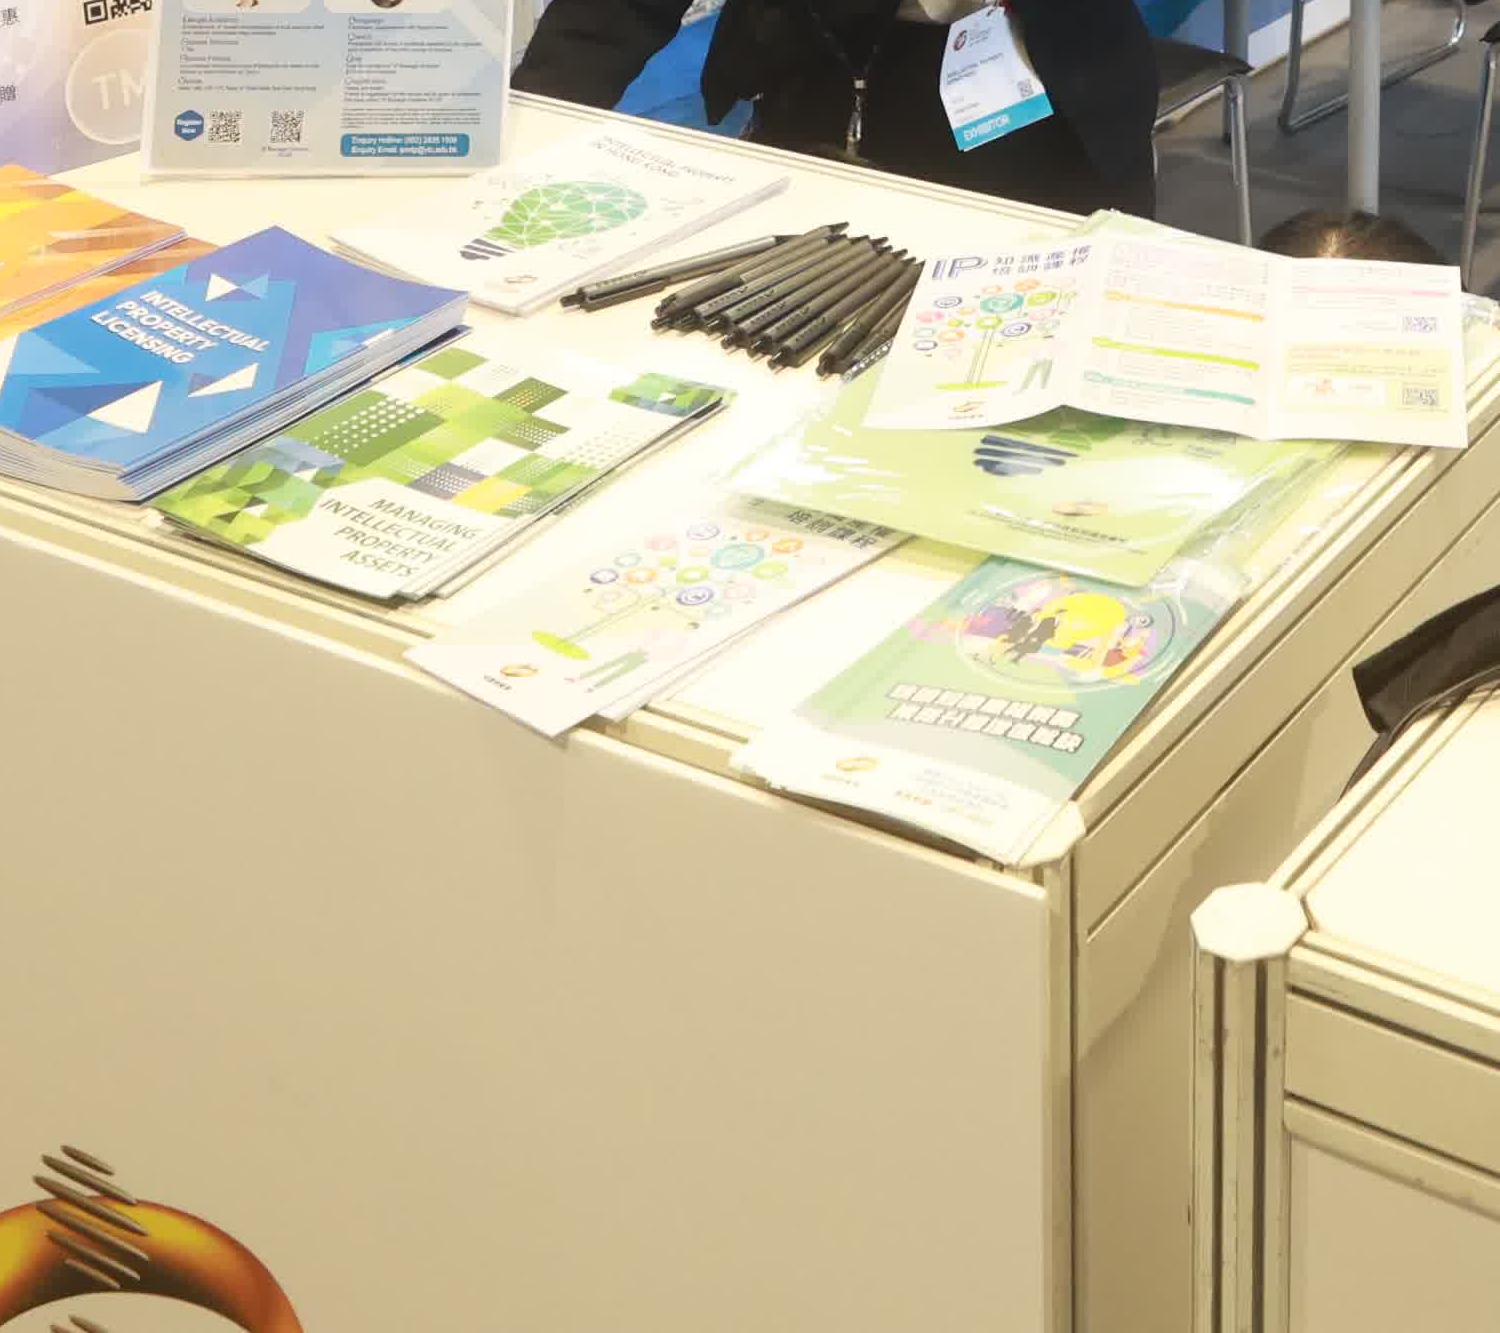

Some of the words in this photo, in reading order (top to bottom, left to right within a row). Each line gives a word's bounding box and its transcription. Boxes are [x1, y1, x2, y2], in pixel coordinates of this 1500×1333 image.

[930, 253, 989, 282] IP
[90, 309, 198, 367] LICENSING
[113, 298, 220, 353] PROPERTY
[138, 287, 272, 355] INTELLECTUAL
[319, 497, 458, 552] INTELLECTUAL
[333, 524, 436, 564] PROPERTY
[367, 498, 478, 541] MANAGING
[339, 549, 421, 578] ASSETS
